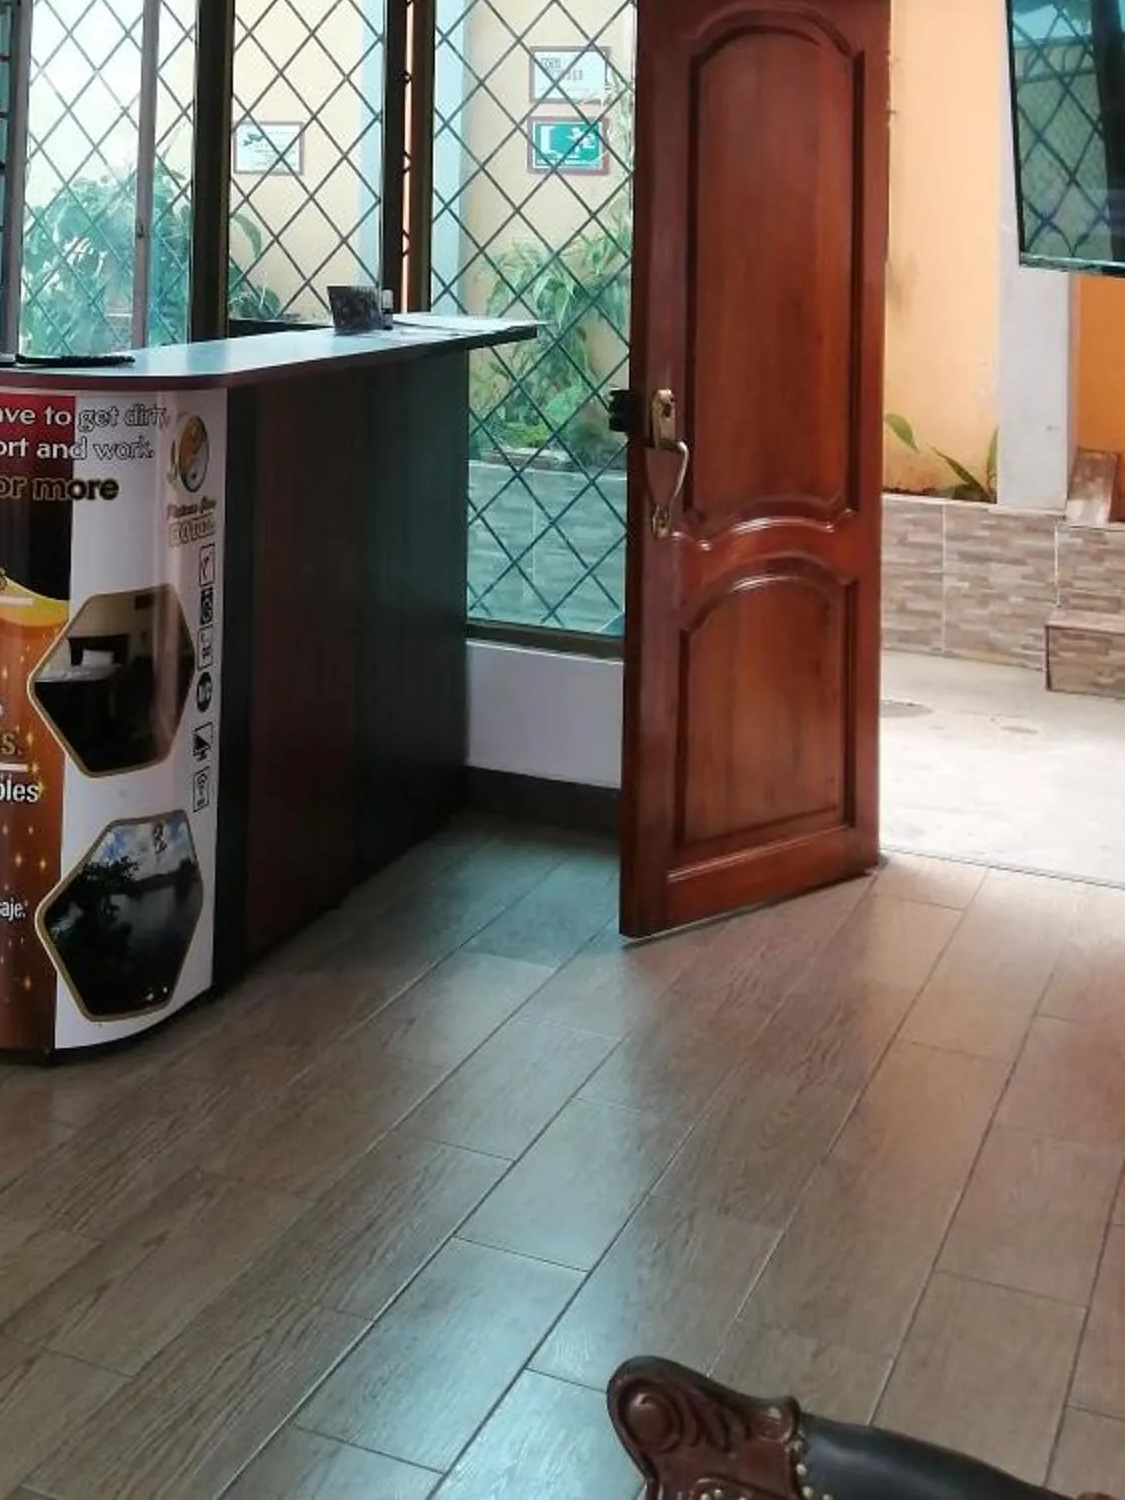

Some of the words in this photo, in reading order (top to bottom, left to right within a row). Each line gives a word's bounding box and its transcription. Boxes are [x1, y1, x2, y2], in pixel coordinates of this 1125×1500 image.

[45, 406, 72, 426] to
[78, 406, 119, 432] get
[36, 436, 89, 461] and
[32, 476, 120, 501] more
